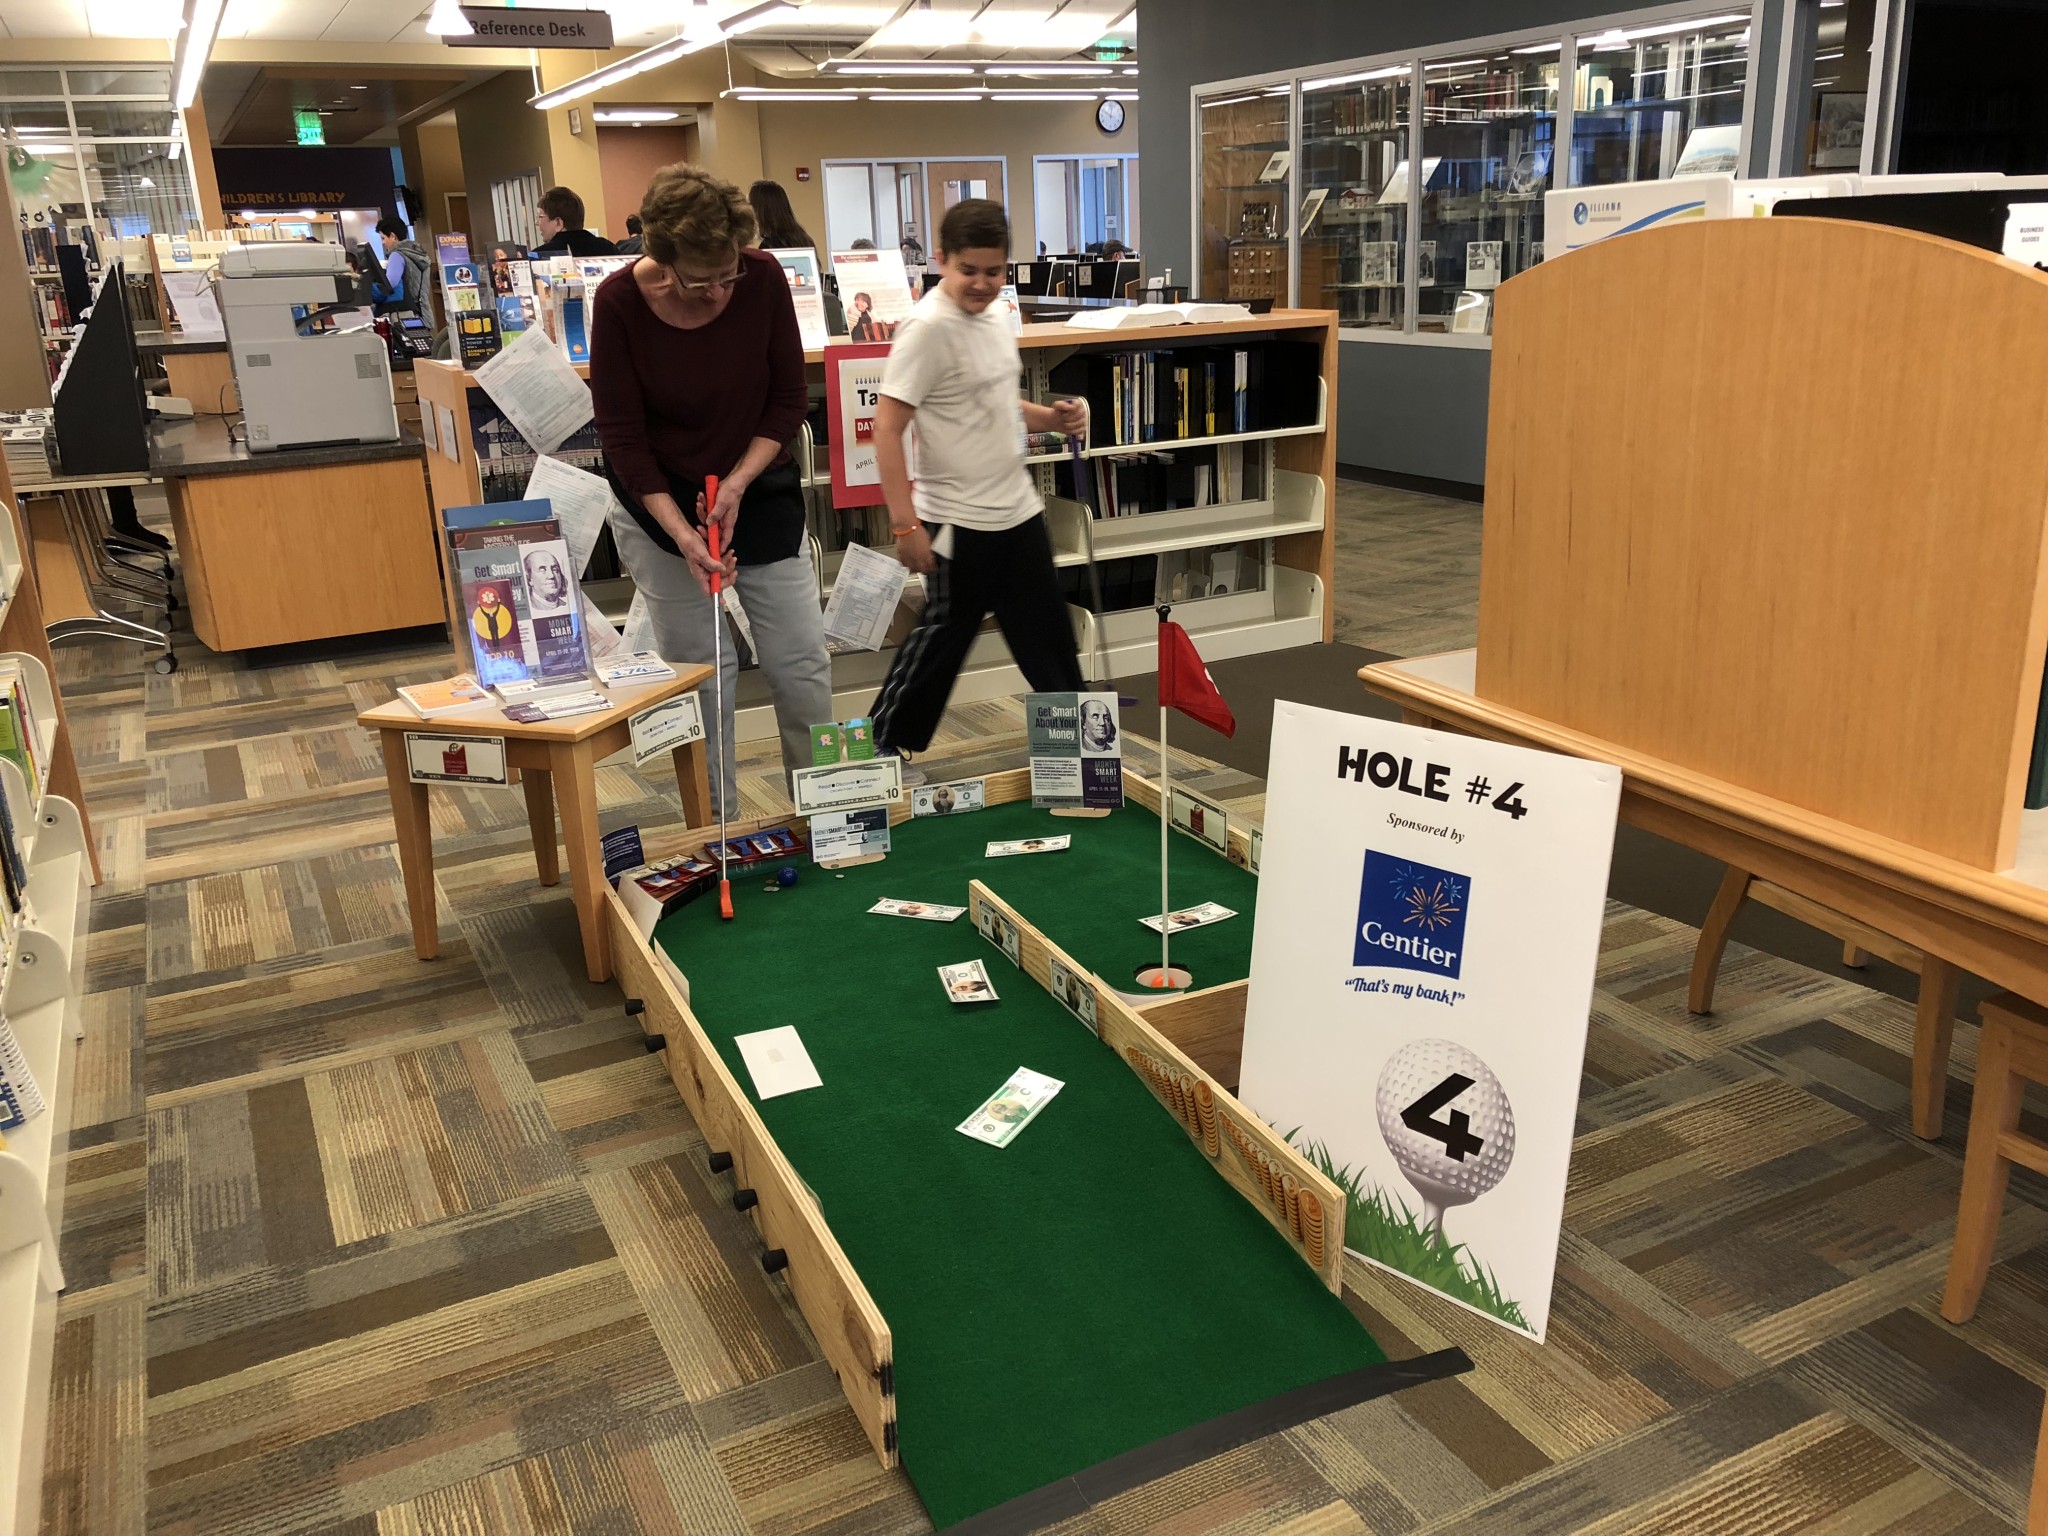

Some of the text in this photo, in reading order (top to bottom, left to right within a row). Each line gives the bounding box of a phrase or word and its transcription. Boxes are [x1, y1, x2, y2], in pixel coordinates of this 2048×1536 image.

[470, 20, 586, 37] Reference Desk
[221, 191, 346, 204] HILDREN'S LIBRARY
[439, 235, 467, 244] EXPAND
[857, 389, 880, 407] Ta
[855, 458, 874, 470] APRIL
[482, 534, 515, 544] TAKING THE
[474, 560, 521, 578] Get Smart
[550, 626, 572, 637] SMAR
[504, 650, 515, 659] 10
[1037, 706, 1077, 717] Get Smart
[1035, 717, 1078, 729] About Your
[688, 724, 701, 738] 10
[1048, 728, 1078, 741] Money!
[1094, 760, 1117, 769] MONEY
[1095, 768, 1118, 776] SMART
[1100, 775, 1119, 784] WEEK
[1338, 745, 1529, 820] HOLE #4
[885, 787, 899, 799] 10
[1386, 812, 1466, 844] Sponsored by
[1361, 921, 1457, 968] Centier
[1391, 983, 1414, 999] my
[1415, 984, 1466, 1007] bank!”
[1399, 1072, 1485, 1164] 4
